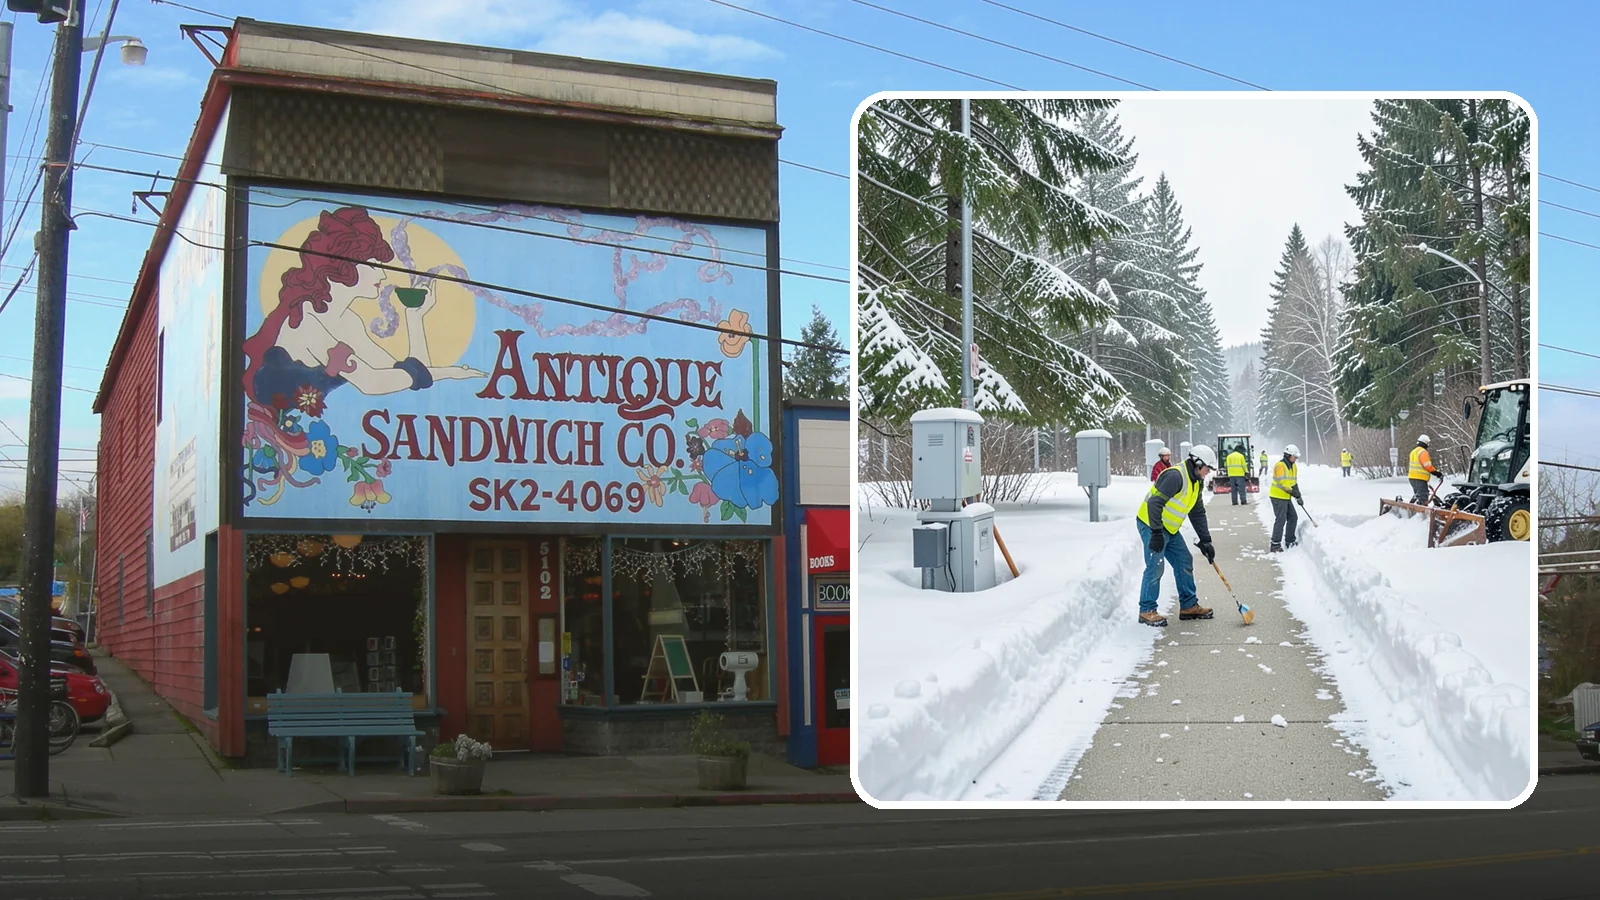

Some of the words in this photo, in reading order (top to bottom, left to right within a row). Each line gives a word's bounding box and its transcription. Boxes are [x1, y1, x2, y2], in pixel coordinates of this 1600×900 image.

[476, 329, 724, 421] ANTIQUE
[361, 408, 604, 467] SANDWICH
[617, 421, 685, 469] CO.
[468, 477, 646, 514] SK2-4069
[539, 541, 552, 600] 5102
[809, 555, 834, 568] BOOKS
